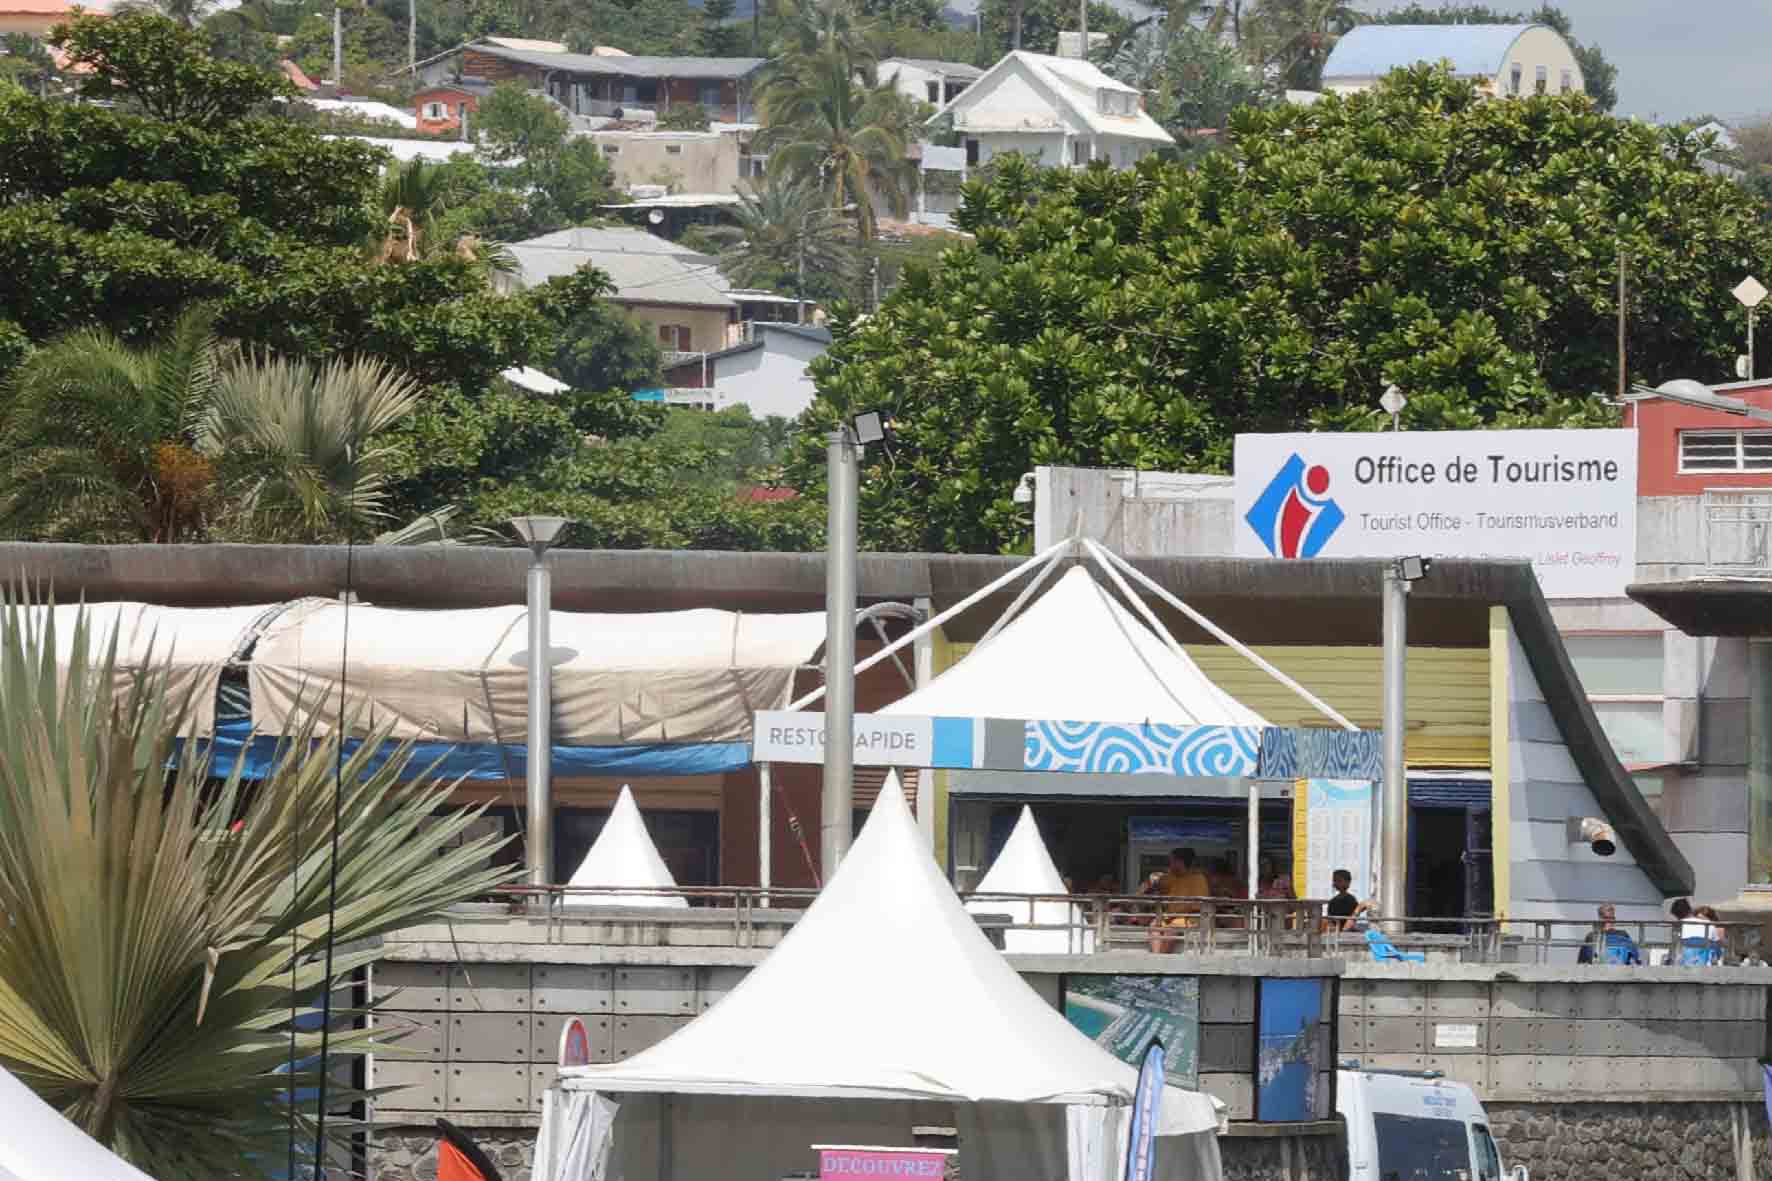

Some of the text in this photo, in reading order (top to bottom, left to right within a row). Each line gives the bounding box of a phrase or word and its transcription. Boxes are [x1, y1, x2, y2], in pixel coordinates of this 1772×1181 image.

[1354, 454, 1619, 484] Office de Tourisme
[1360, 513, 1413, 531] Tourist
[1416, 514, 1461, 531] Office
[1477, 512, 1619, 530] Tourismusverband
[855, 730, 916, 750] APIDE
